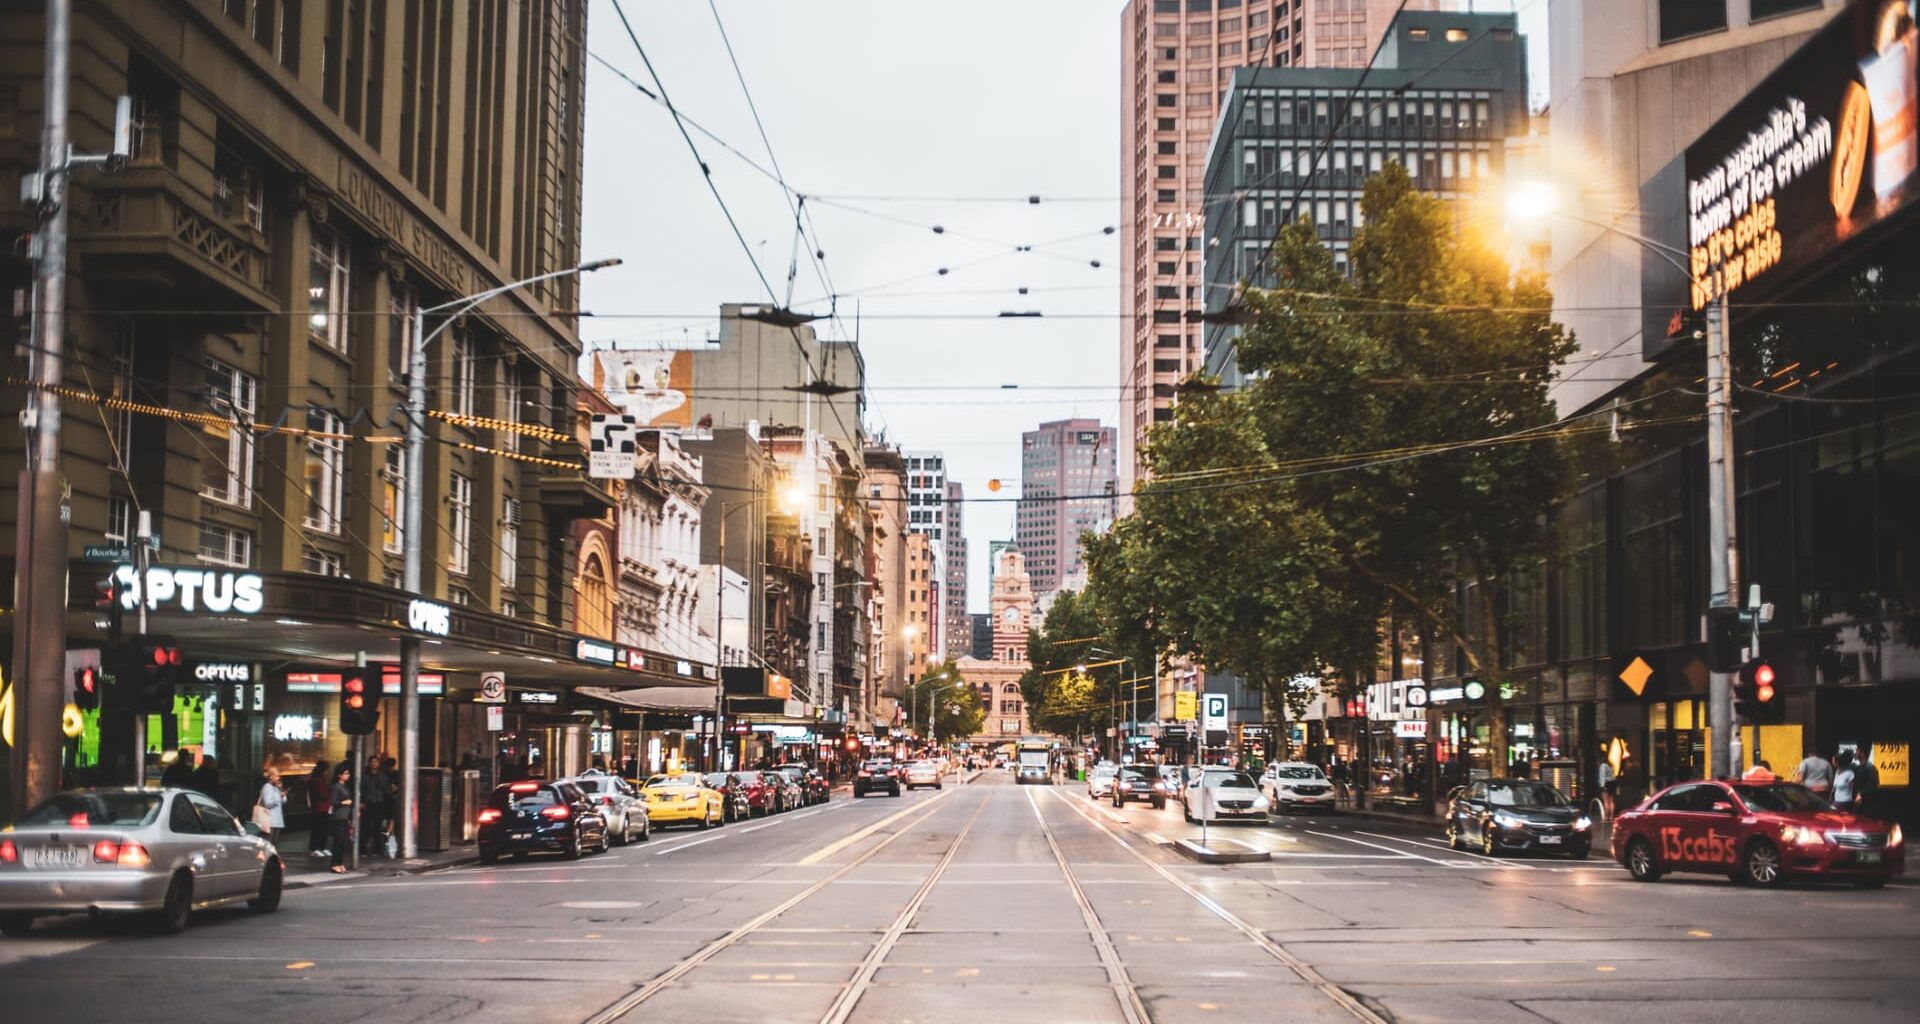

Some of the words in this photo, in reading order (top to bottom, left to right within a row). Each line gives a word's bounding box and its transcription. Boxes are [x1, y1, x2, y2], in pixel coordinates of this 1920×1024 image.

[1689, 165, 1726, 215] from
[1723, 97, 1806, 187] australia's
[1689, 196, 1732, 247] home
[1731, 172, 1750, 219] of
[1750, 164, 1775, 204] ice
[1775, 115, 1832, 190] cream
[337, 155, 404, 243] LONDON
[413, 219, 465, 291] STORES
[1734, 198, 1776, 251] coles
[1745, 229, 1782, 283] aisle
[91, 548, 119, 557] Bourke
[121, 549, 130, 557] St
[408, 599, 450, 637] OPTUS
[195, 663, 249, 681] OPTUS
[484, 681, 501, 693] 40
[1211, 700, 1222, 715] P
[274, 714, 313, 741] OPTUS
[1661, 826, 1737, 864] 13cabs
